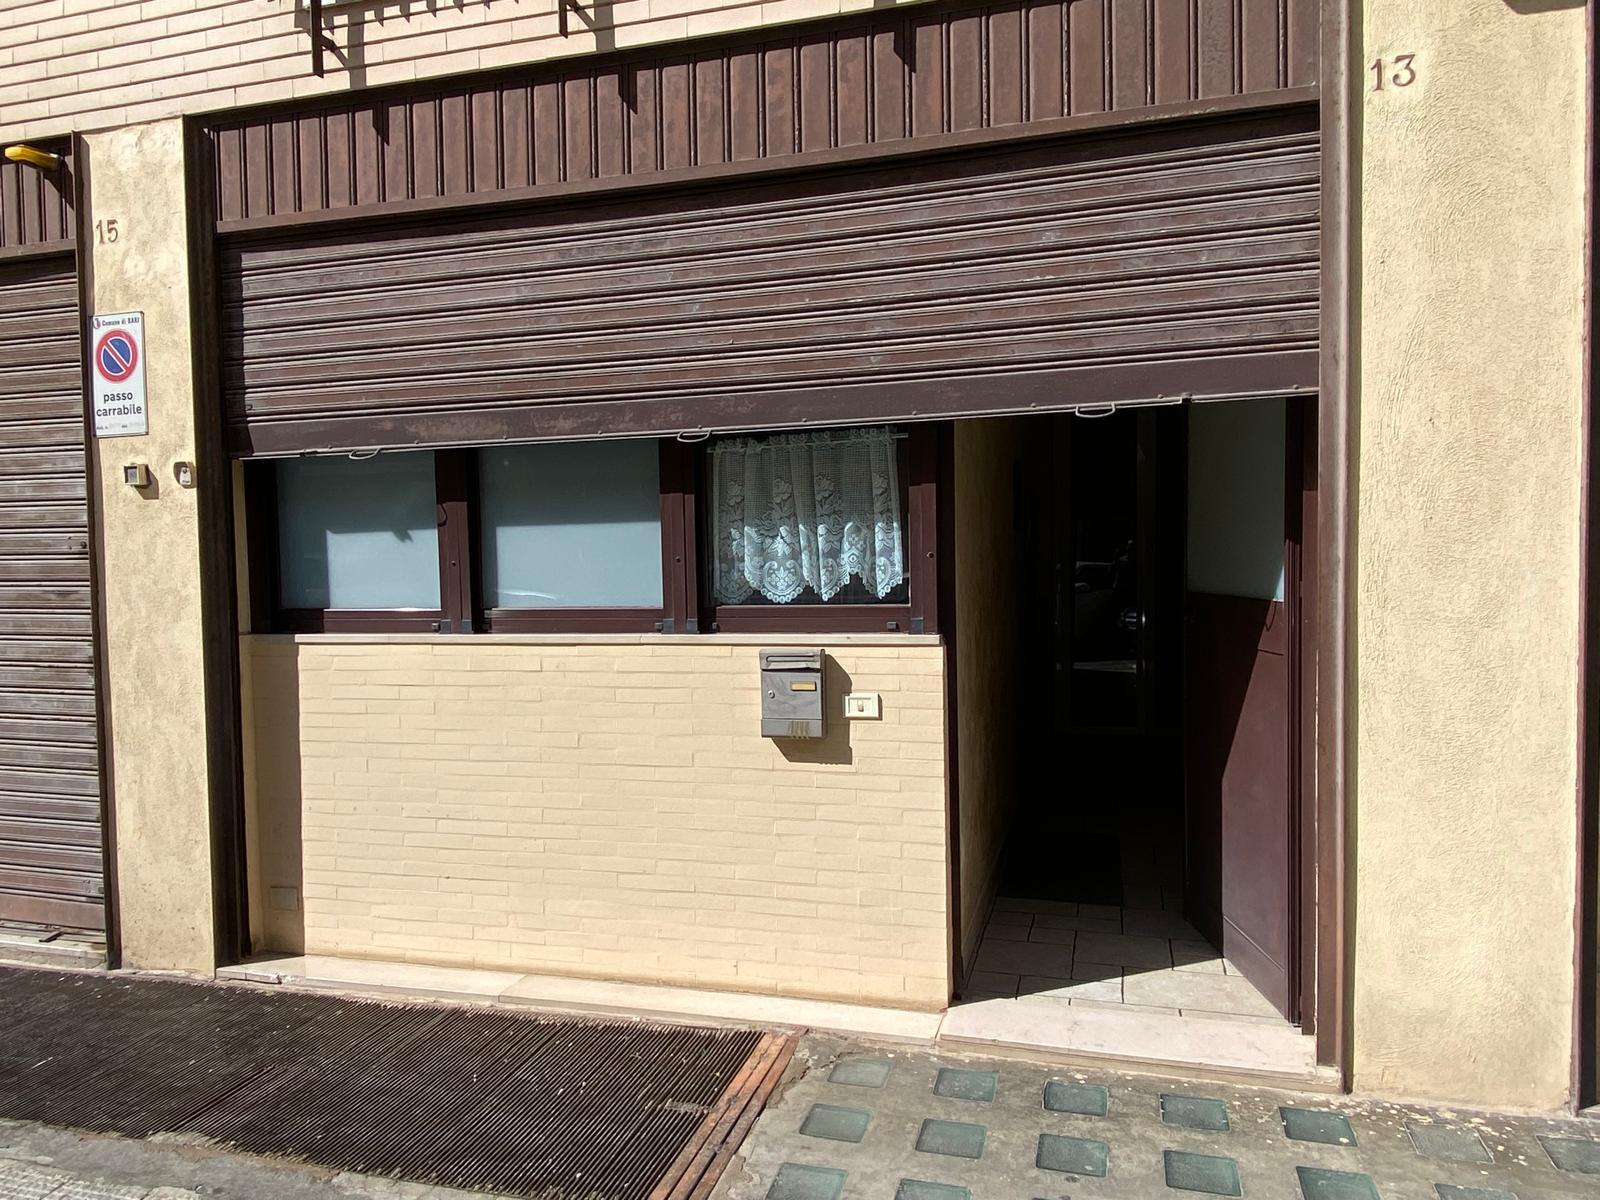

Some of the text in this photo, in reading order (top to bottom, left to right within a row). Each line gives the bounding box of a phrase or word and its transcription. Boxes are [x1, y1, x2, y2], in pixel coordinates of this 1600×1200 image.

[1370, 54, 1416, 92] 13
[96, 219, 118, 245] 15
[103, 392, 133, 404] passo
[96, 404, 142, 417] carrabile
